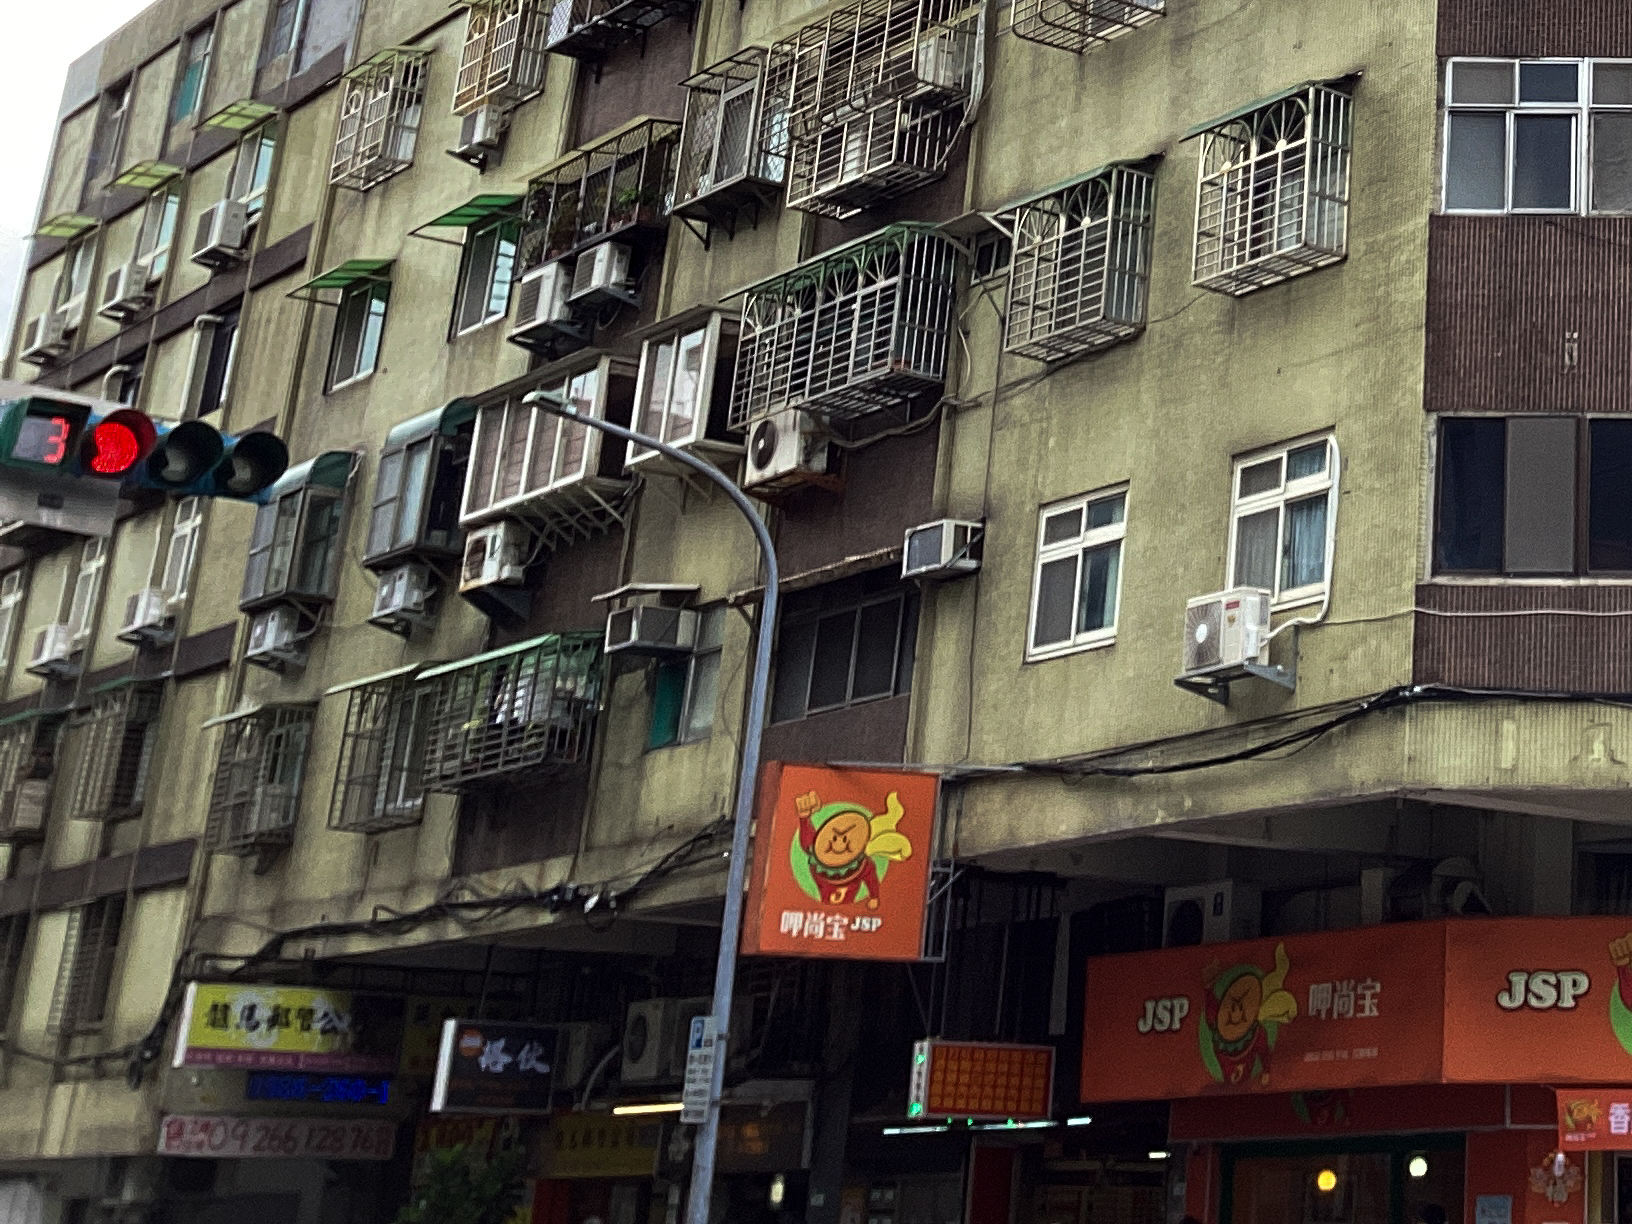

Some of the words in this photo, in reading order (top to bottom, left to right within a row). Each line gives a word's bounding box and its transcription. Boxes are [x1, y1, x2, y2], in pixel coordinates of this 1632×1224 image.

[44, 416, 70, 464] 3
[780, 910, 849, 941] 呷尚宝
[850, 916, 883, 932] JSP
[1308, 979, 1381, 1020] 呷尚宝
[1498, 969, 1590, 1011] JSP
[1137, 997, 1190, 1033] JSP
